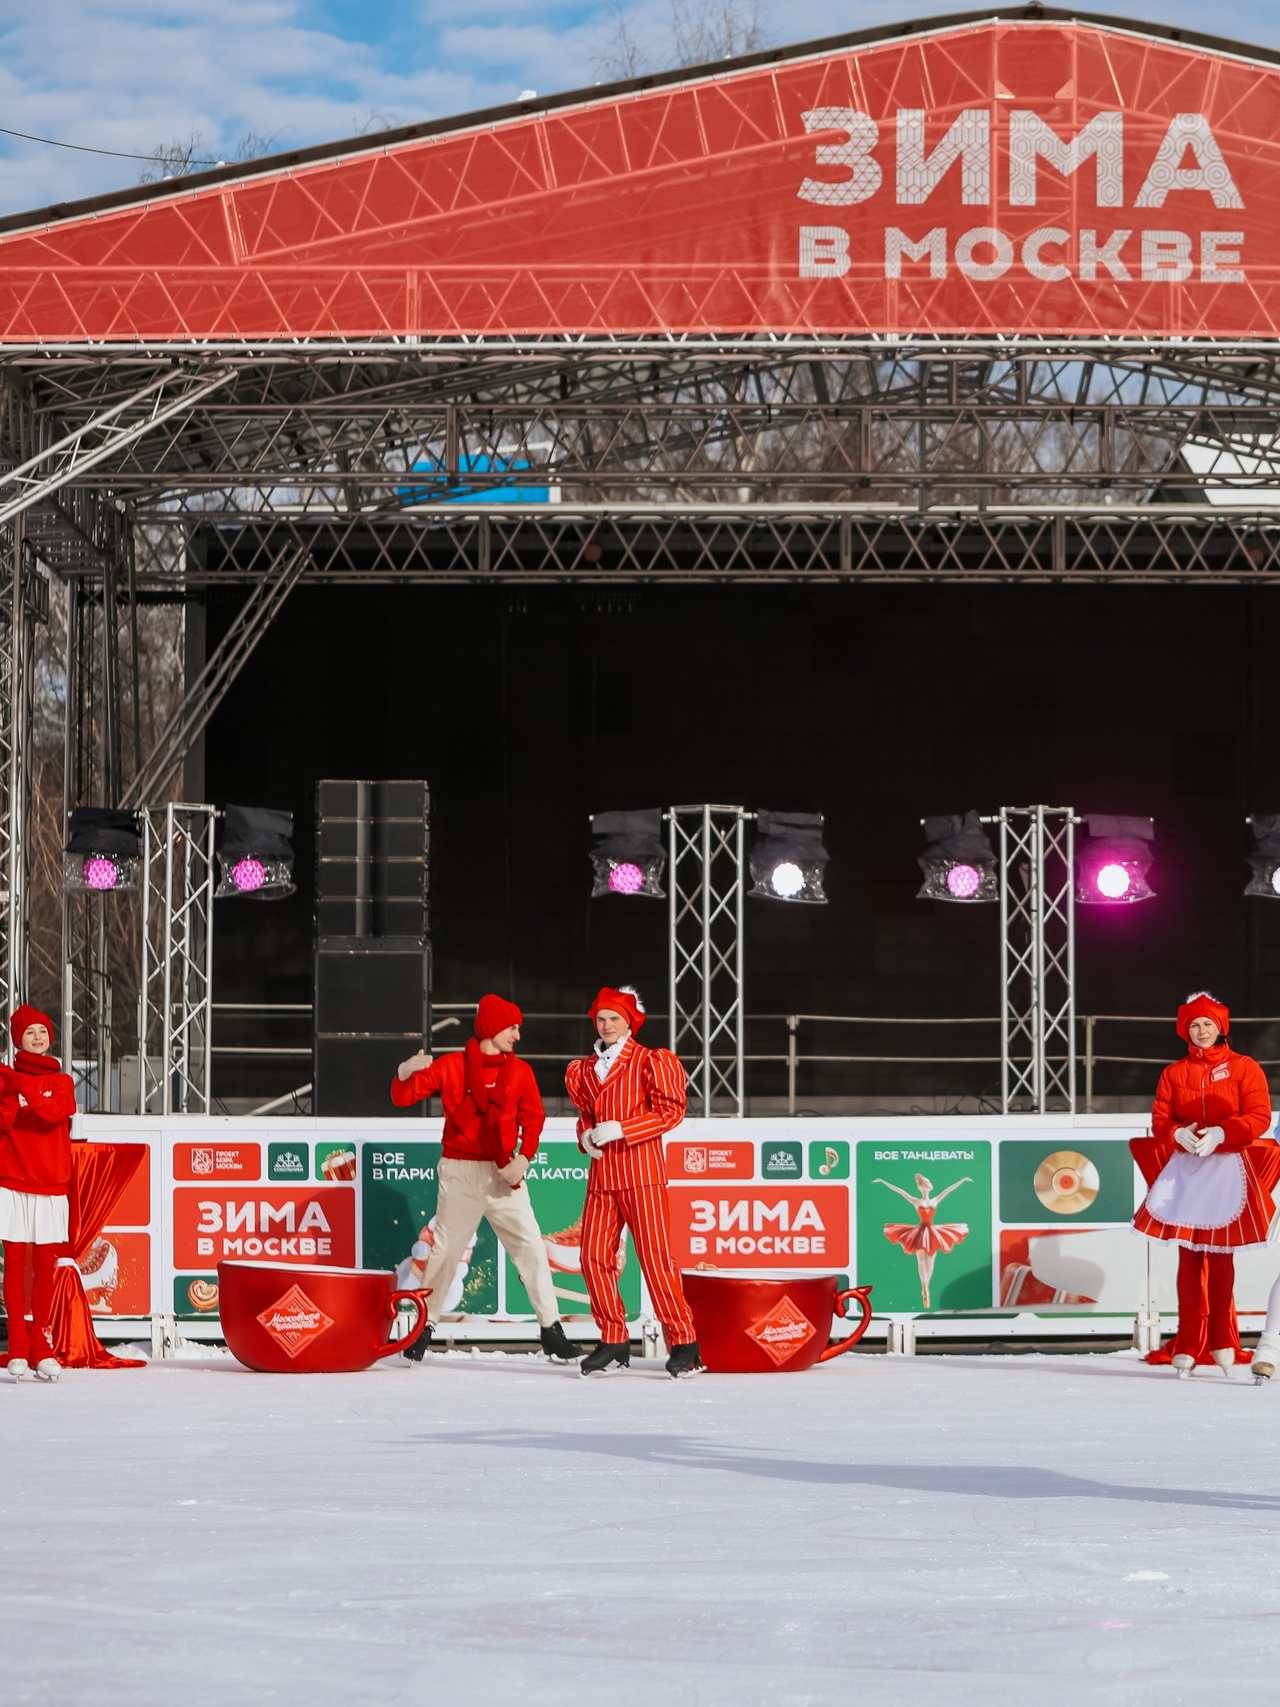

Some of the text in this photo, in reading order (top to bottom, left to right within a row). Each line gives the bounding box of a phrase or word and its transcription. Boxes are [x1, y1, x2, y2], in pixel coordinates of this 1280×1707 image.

[797, 106, 1246, 209] ЗИМА
[798, 226, 1246, 283] В МОСКВЕ
[372, 1152, 405, 1165] ВСЕ
[874, 1150, 974, 1161] ВСЕ ТАНЦЕВАТЬ!
[372, 1167, 435, 1180] В ПАРК!
[541, 1167, 590, 1180] КАТО
[197, 1200, 332, 1233] ЗИМА
[689, 1199, 826, 1232] ЗИМА
[197, 1237, 332, 1256] В МОСКВЕ
[690, 1235, 826, 1254] В МОСКВЕ
